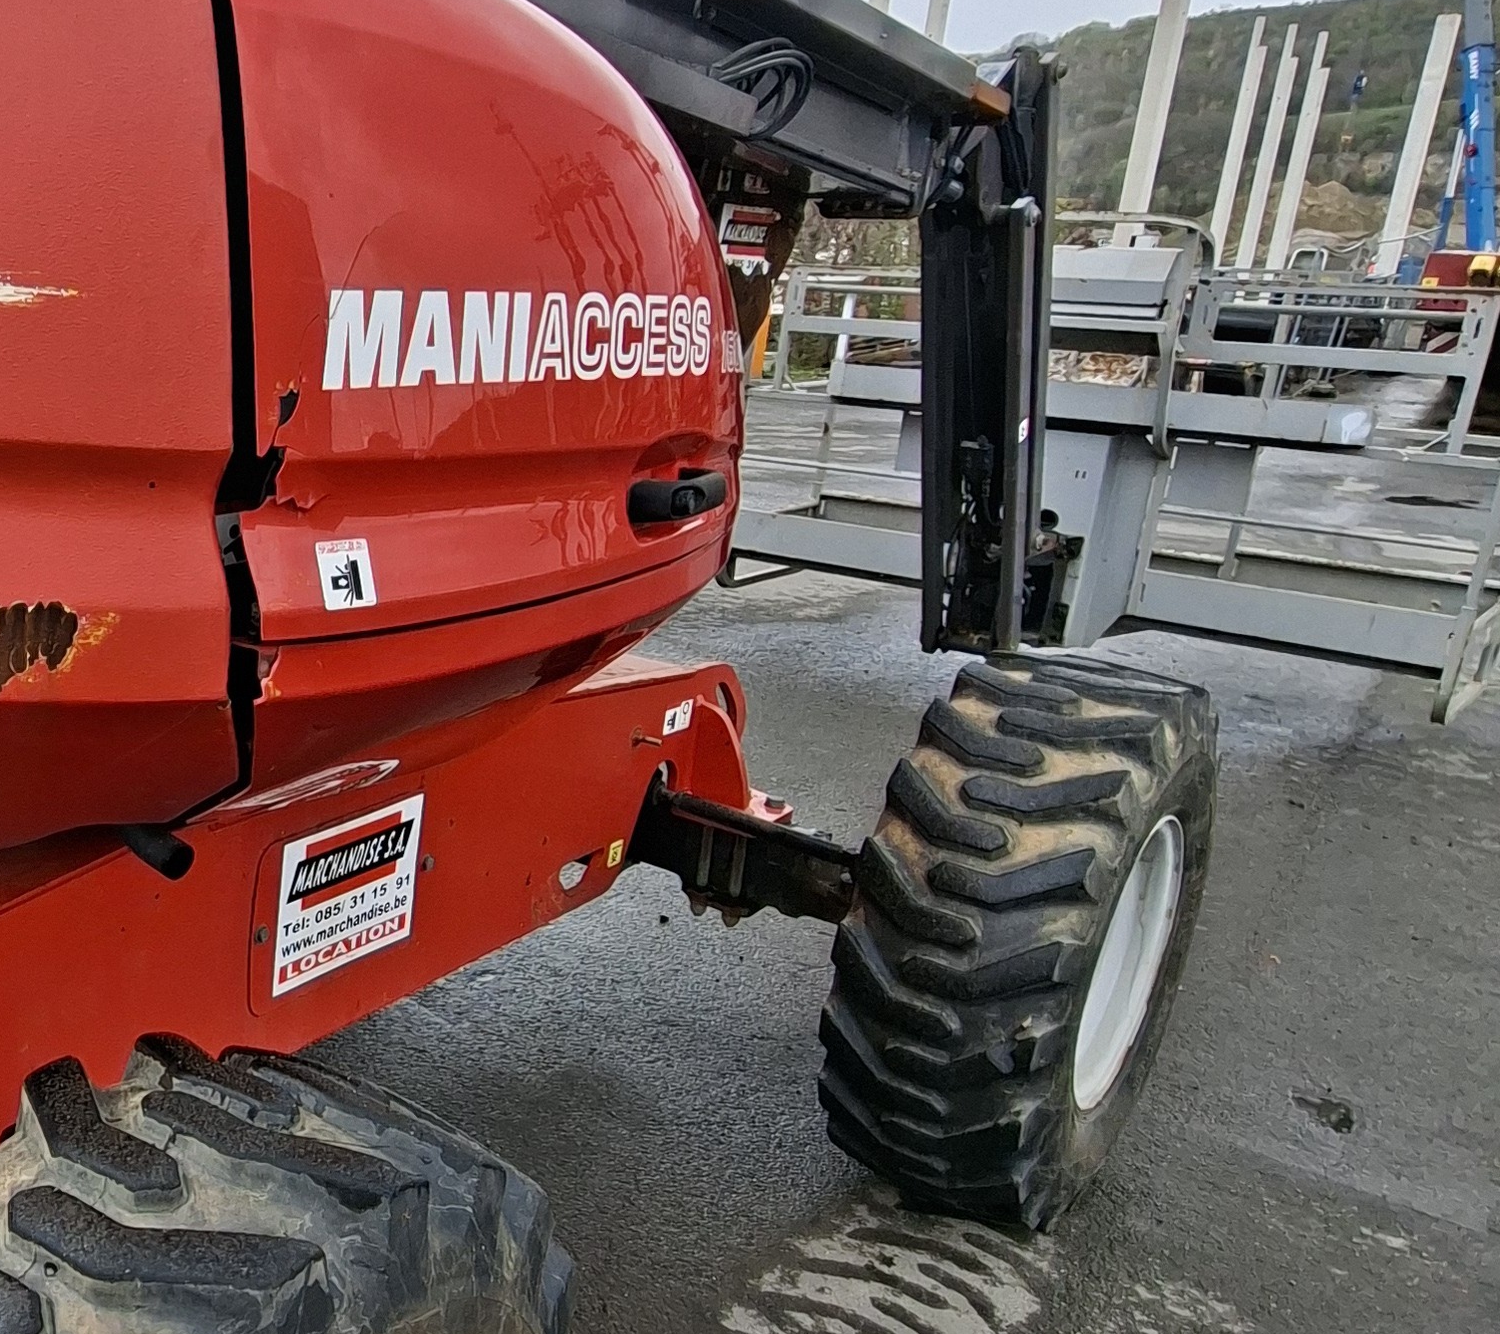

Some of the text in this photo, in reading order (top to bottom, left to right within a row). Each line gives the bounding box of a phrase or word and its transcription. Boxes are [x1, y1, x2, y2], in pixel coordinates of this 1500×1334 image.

[322, 289, 712, 391] MANIACCESS
[291, 826, 406, 896] MARCHANDISE S.A.
[281, 893, 408, 958] www.marchandise.be
[283, 873, 411, 938] Tél: 085/ 31 15 91
[286, 917, 401, 980] LOCATION
